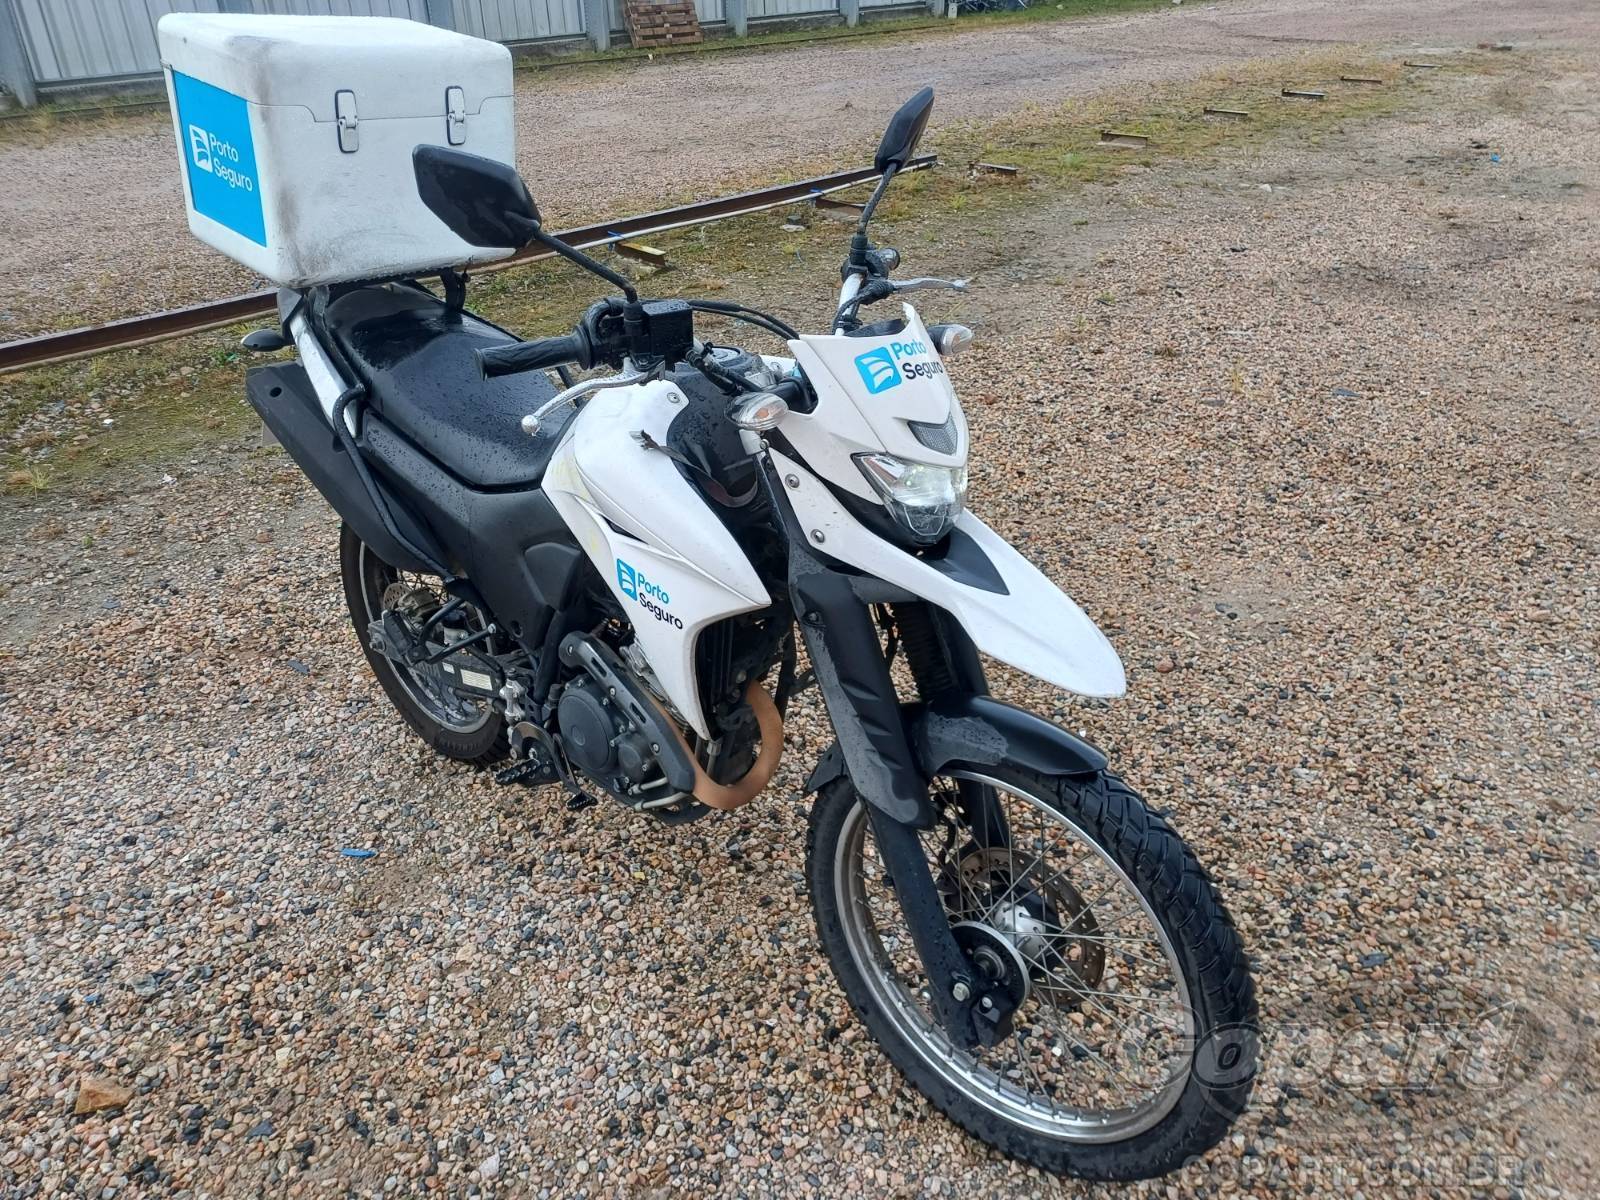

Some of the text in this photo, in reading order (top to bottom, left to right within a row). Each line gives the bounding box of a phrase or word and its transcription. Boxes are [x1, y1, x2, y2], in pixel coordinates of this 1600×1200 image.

[209, 132, 239, 162] Porto
[213, 158, 253, 192] Seguro
[890, 339, 927, 360] Porto
[902, 361, 944, 380] Seguro
[637, 572, 670, 605] Porto
[639, 592, 683, 630] Seguro
